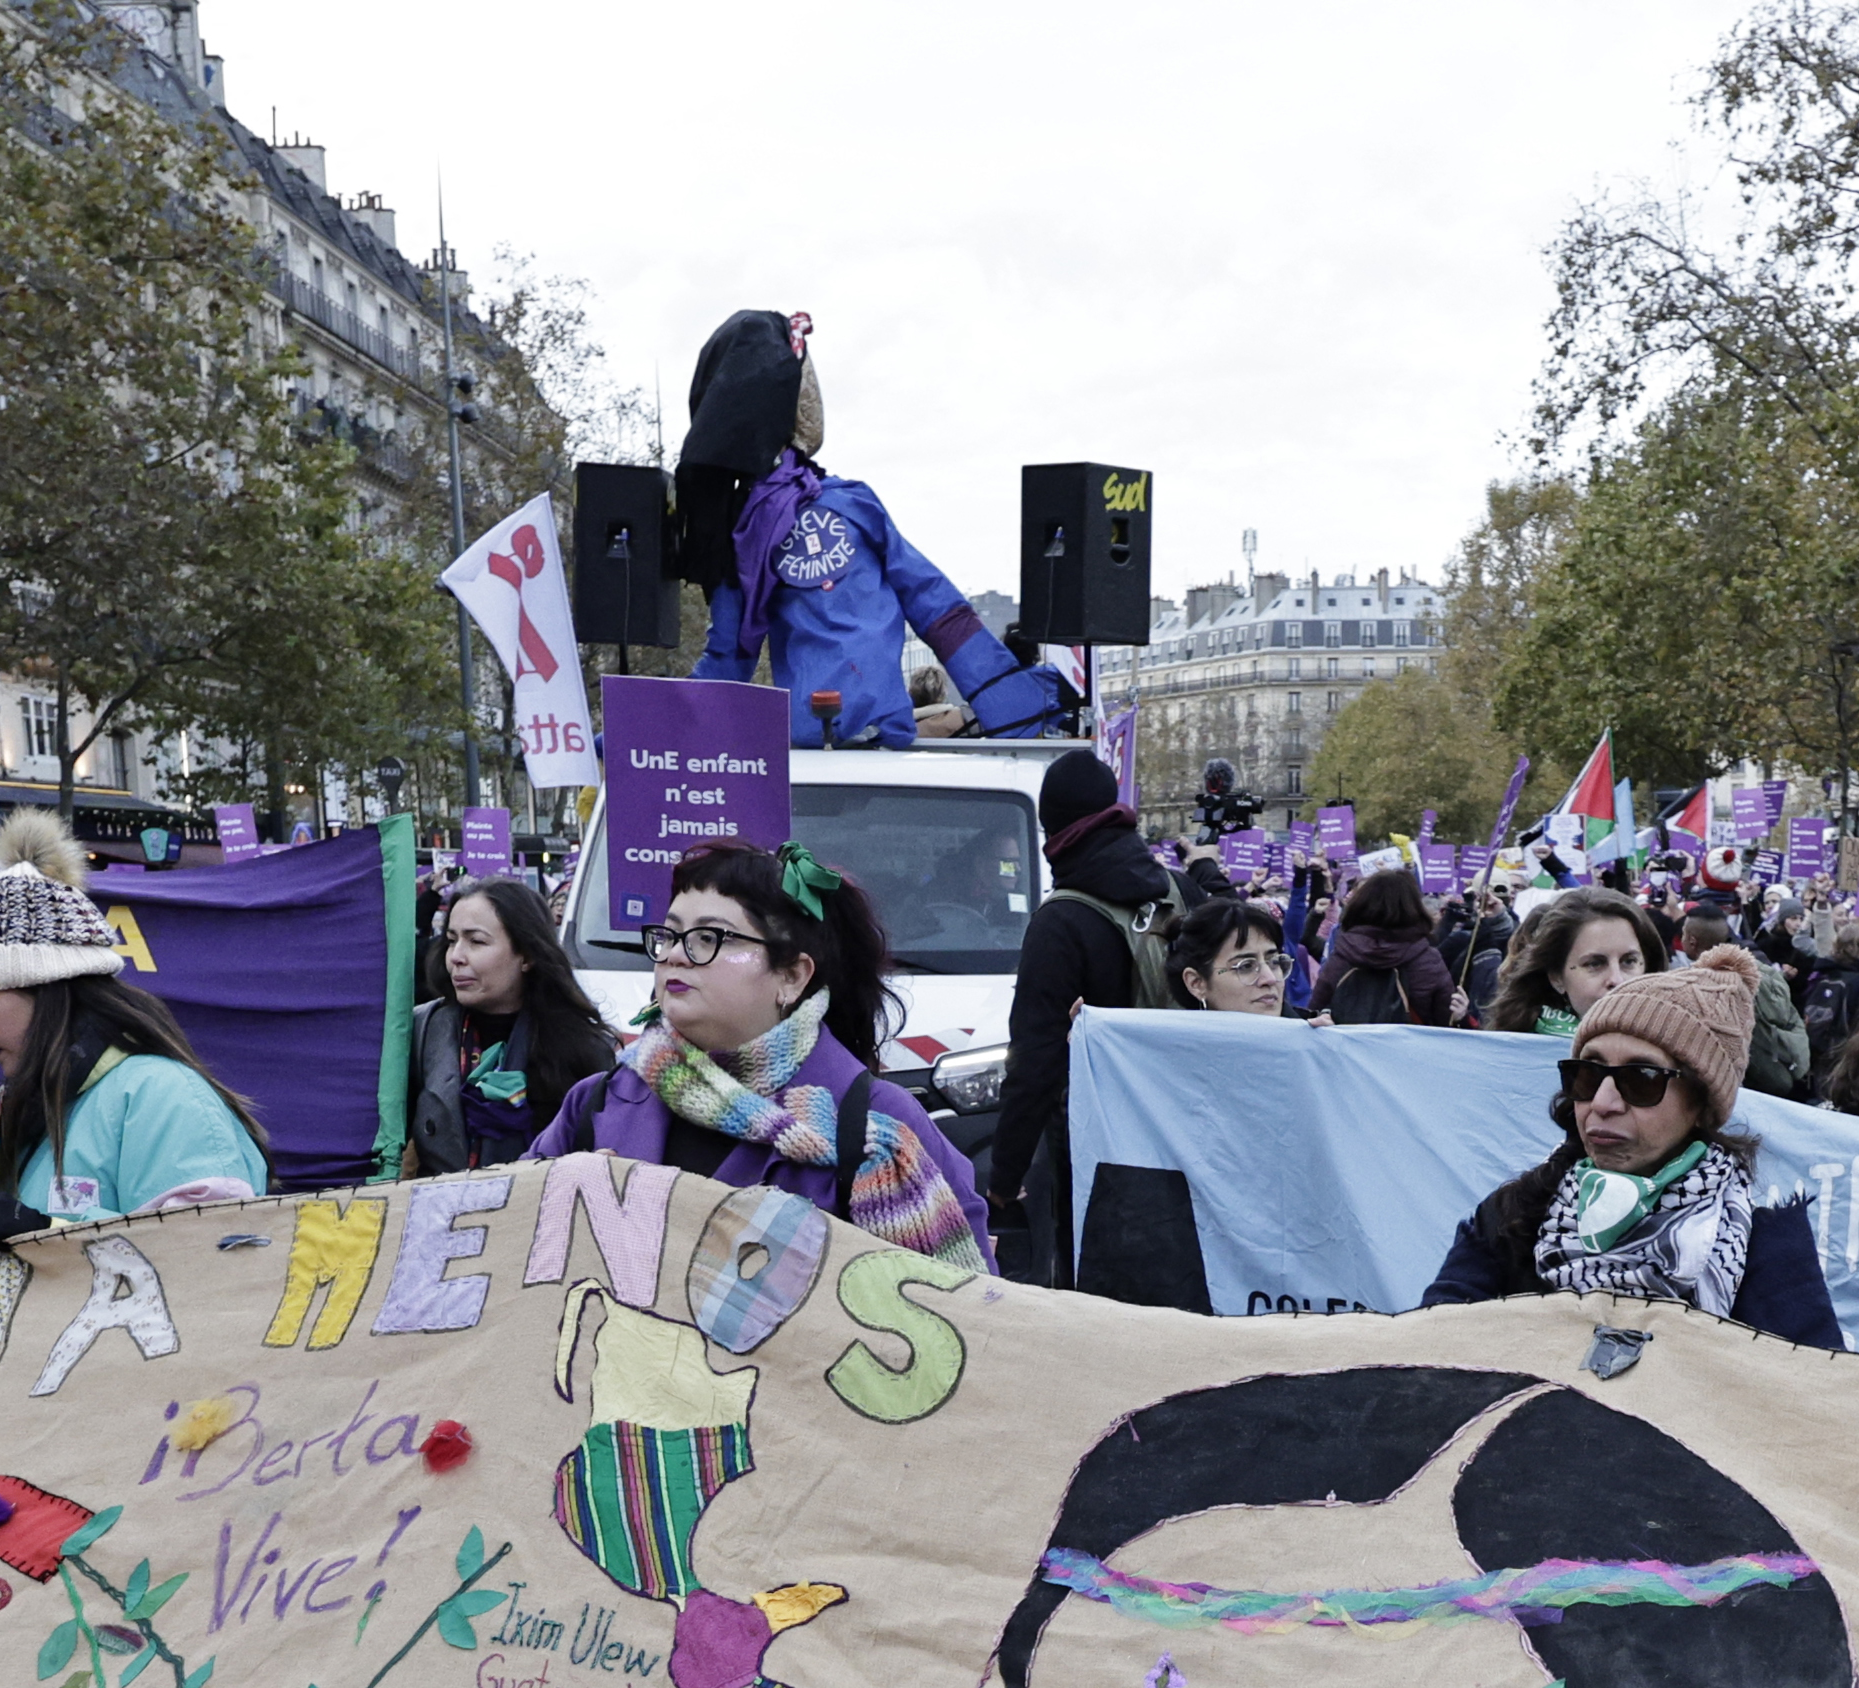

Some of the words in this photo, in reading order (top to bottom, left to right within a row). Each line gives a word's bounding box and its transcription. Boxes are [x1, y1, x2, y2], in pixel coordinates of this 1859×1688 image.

[630, 749, 679, 771] UnE
[687, 752, 768, 775] enfant
[665, 783, 726, 806] n'est
[658, 814, 738, 838] jamais
[261, 1153, 978, 1424] MENOS
[490, 1581, 565, 1650] Ixim
[570, 1603, 660, 1677] Ulew
